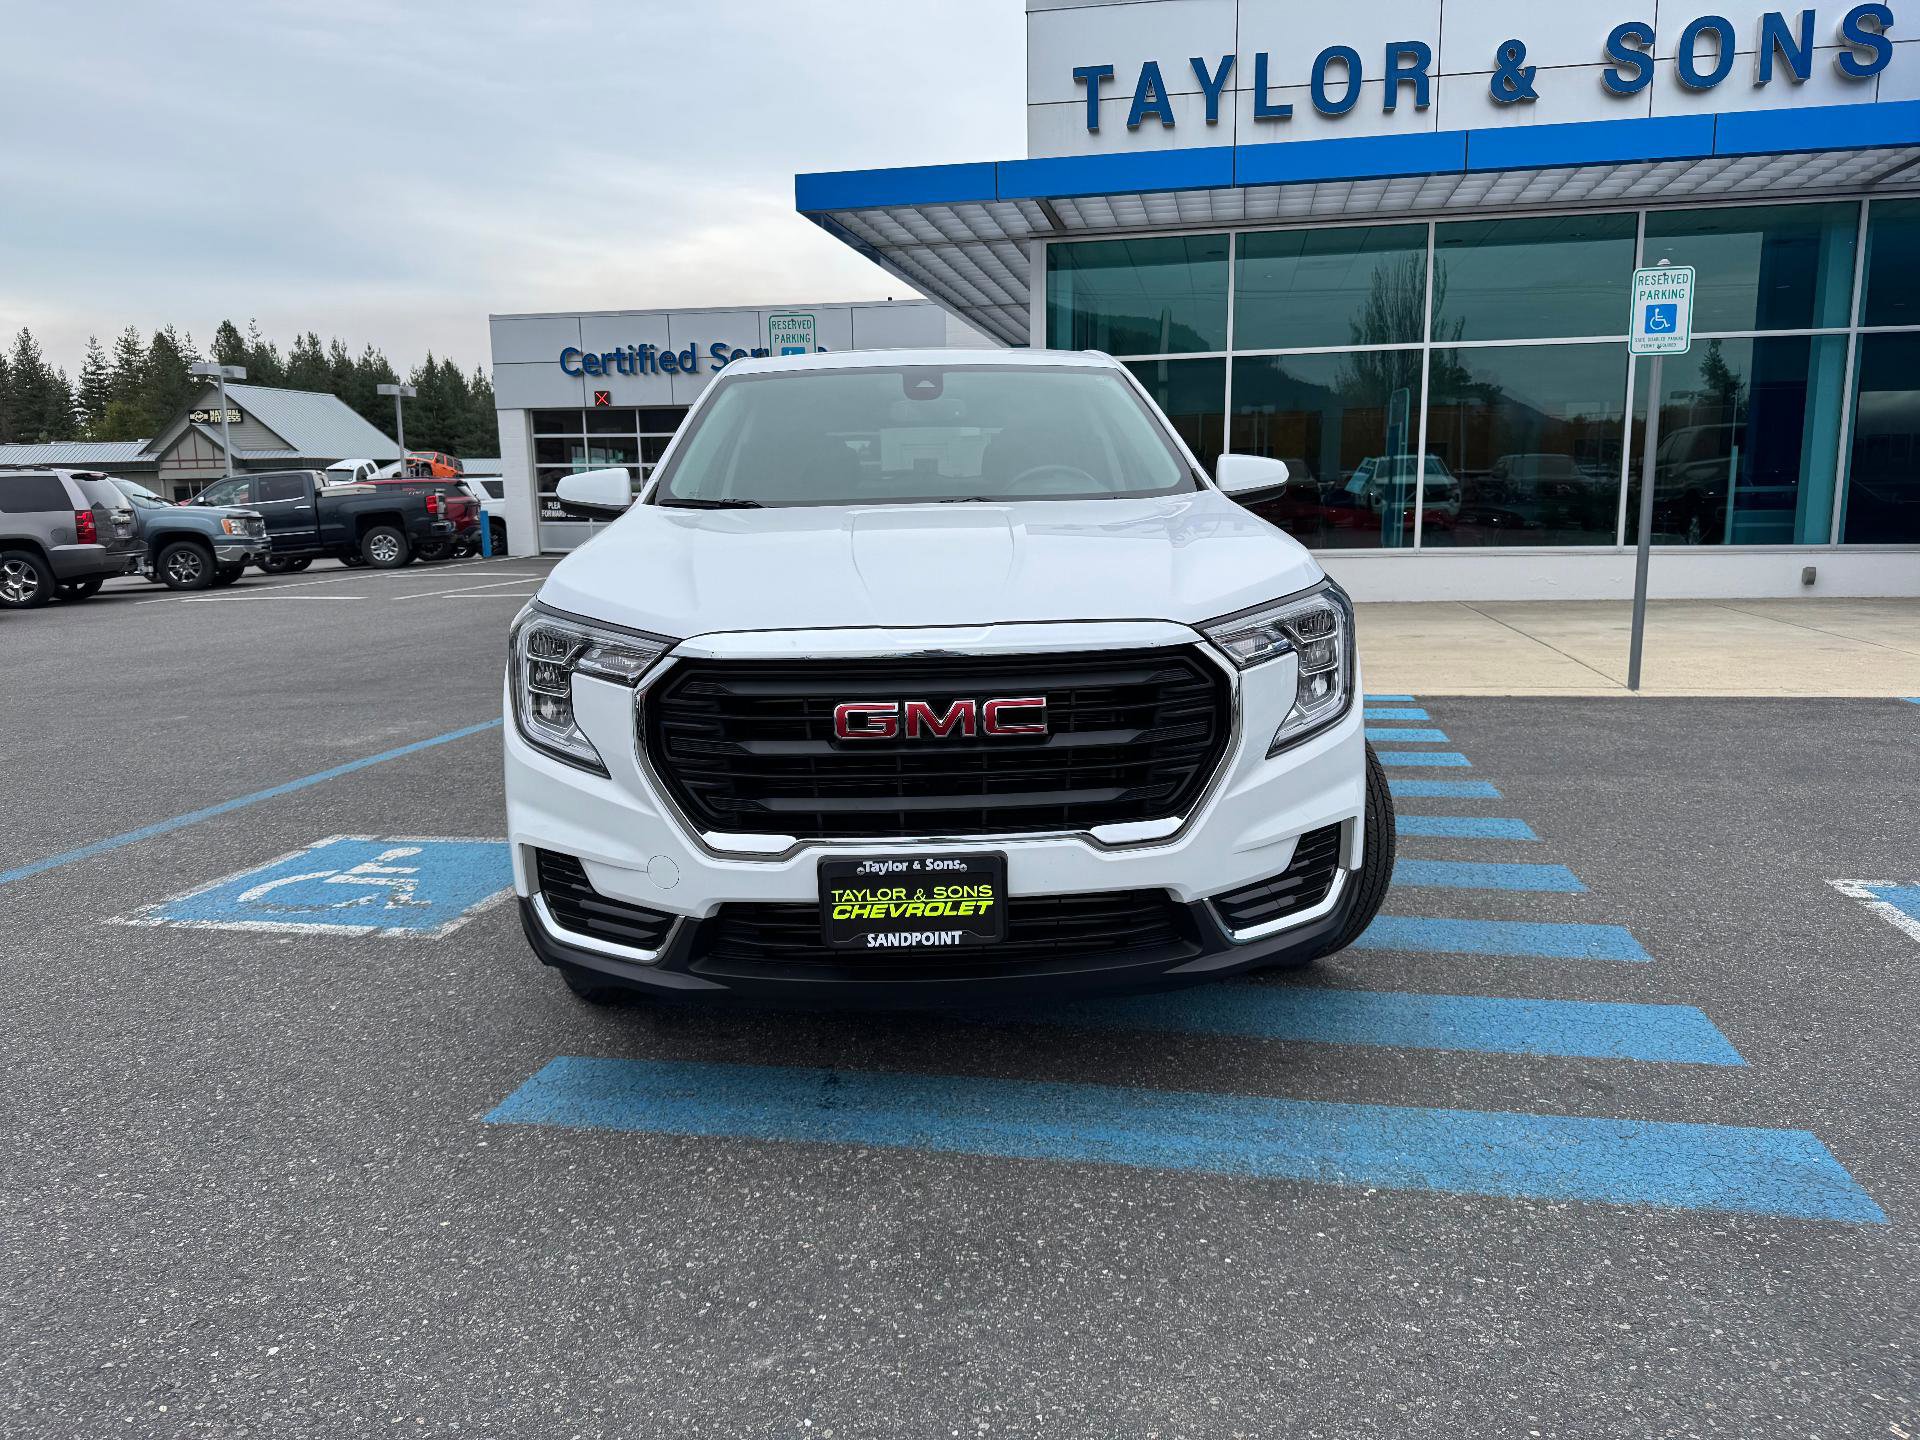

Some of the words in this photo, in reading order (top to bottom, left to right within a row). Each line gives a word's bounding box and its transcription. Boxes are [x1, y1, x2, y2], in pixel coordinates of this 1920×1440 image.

[1073, 40, 1432, 132] TAYLOR
[1488, 39, 1539, 102] &
[1601, 3, 1894, 96] SONS
[1637, 273, 1689, 286] RESERVED
[1639, 288, 1685, 301] PARKING
[771, 318, 812, 331] RESERVED
[774, 333, 811, 344] PARKING
[560, 342, 698, 376] Certified
[834, 696, 1048, 740] GMC
[863, 860, 909, 876] Taylor
[913, 860, 921, 870] &
[925, 858, 961, 871] Sons
[831, 888, 907, 902] TAYLOR
[914, 888, 926, 903] &
[933, 885, 993, 899] SONS
[832, 900, 994, 920] CHEVROLET
[866, 930, 963, 948] SANDPOINT
